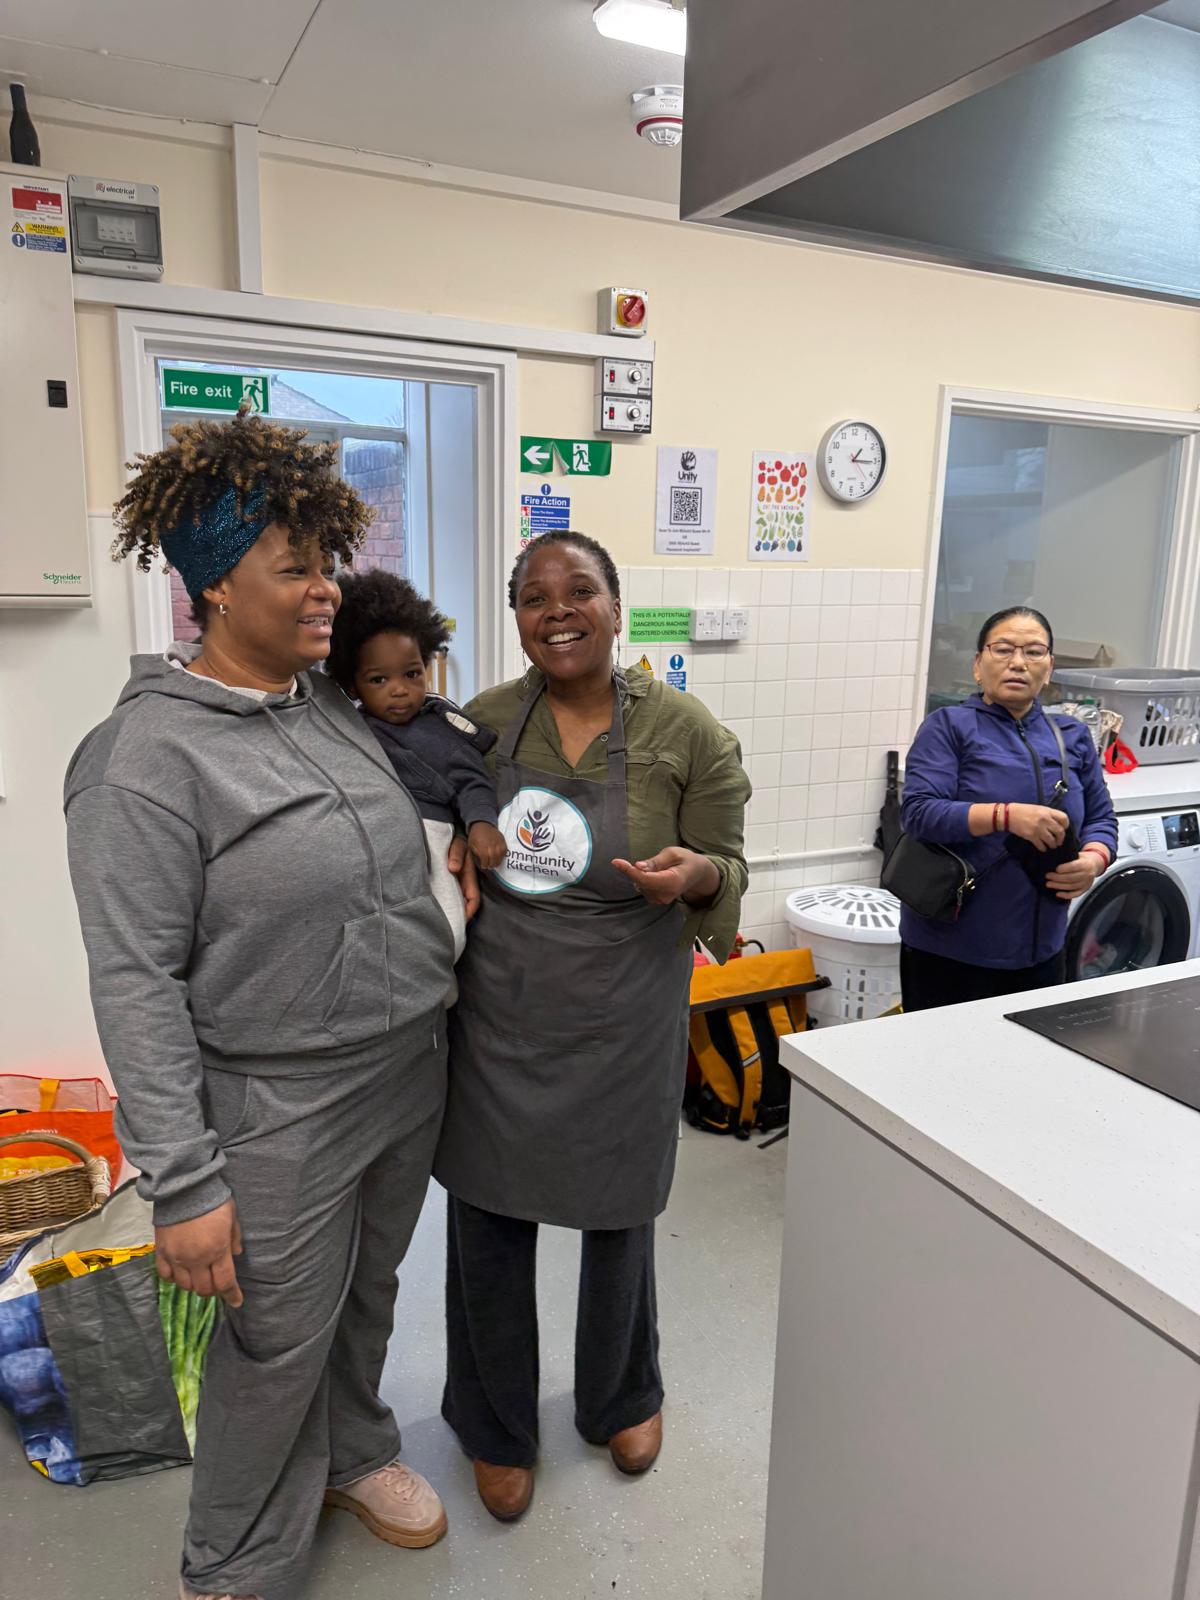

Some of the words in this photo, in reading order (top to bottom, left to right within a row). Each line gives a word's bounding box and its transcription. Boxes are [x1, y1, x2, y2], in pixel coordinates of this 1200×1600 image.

[106, 185, 135, 195] electrical
[170, 380, 198, 396] Fire
[205, 385, 232, 398] exit
[678, 471, 698, 484] Unity
[524, 496, 540, 504] Fire
[541, 497, 567, 506] Action
[505, 849, 575, 871] ommunity
[507, 859, 559, 876] Kitchen
